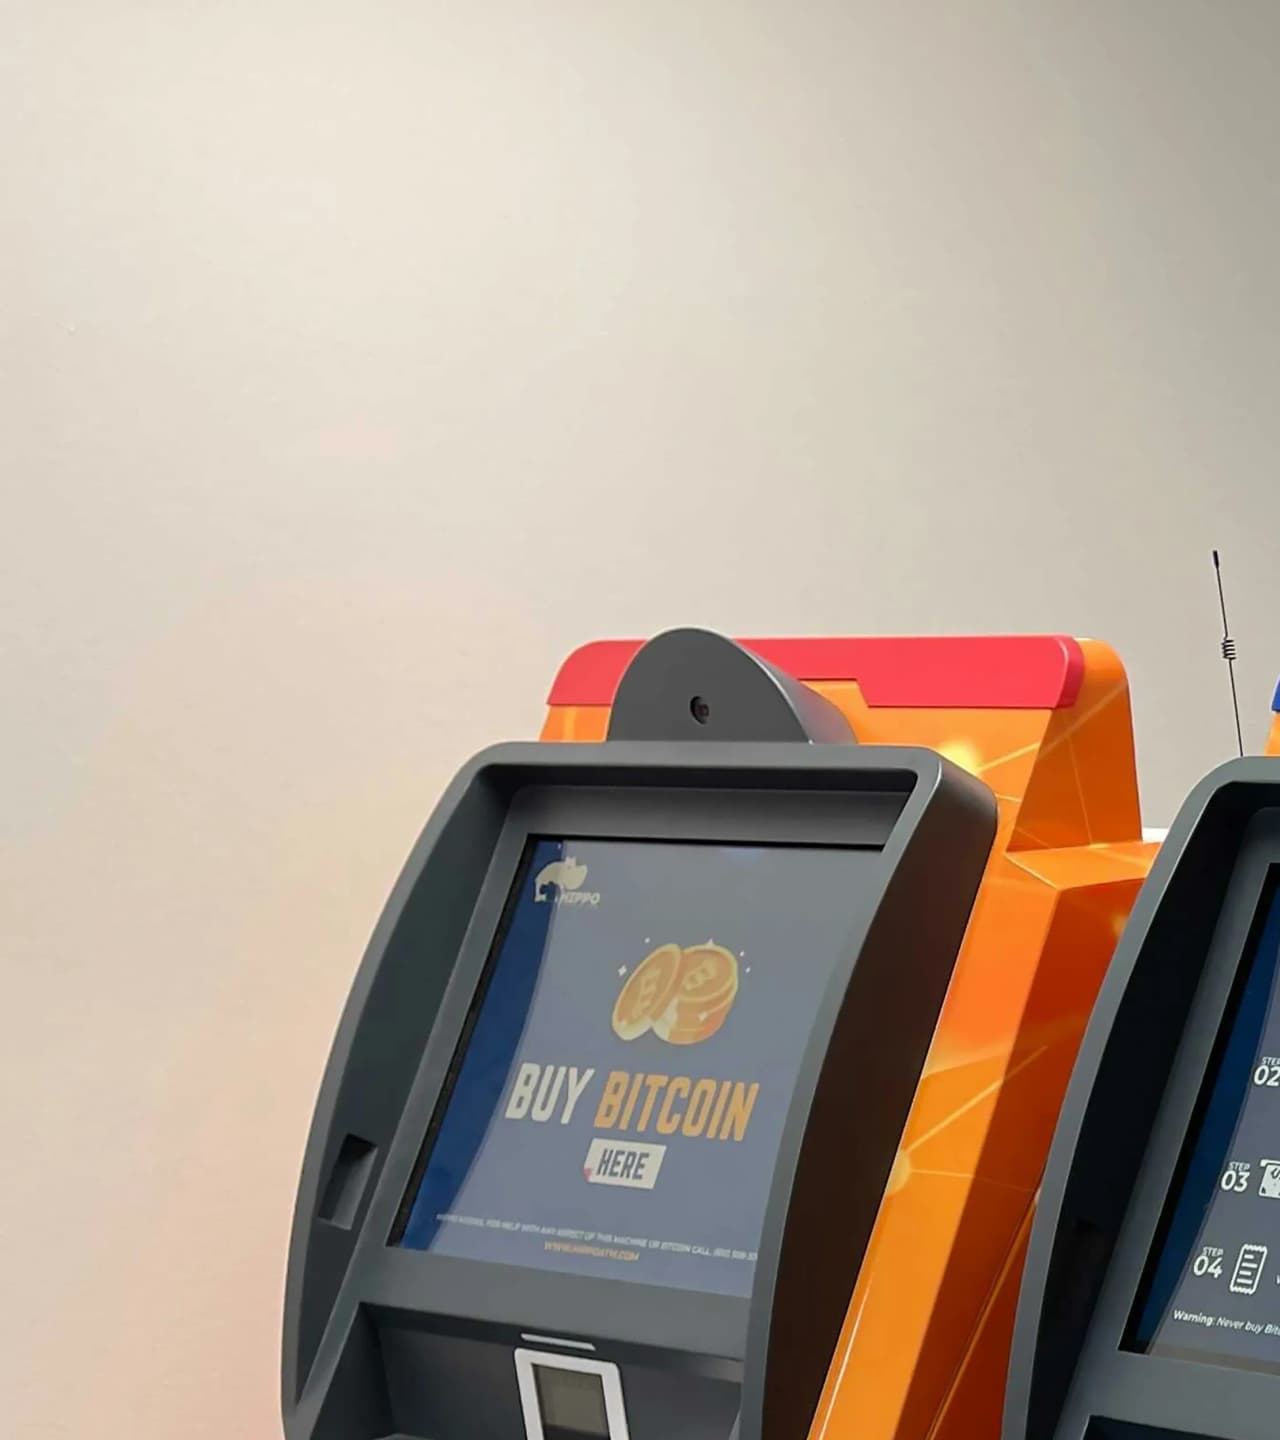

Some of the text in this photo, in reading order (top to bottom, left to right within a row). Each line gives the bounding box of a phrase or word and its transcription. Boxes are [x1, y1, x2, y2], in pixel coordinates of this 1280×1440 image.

[504, 1062, 760, 1142] BUY BITCOIN
[596, 1148, 649, 1180] HERE
[1220, 1169, 1251, 1192] 03
[1193, 1254, 1223, 1279] 04
